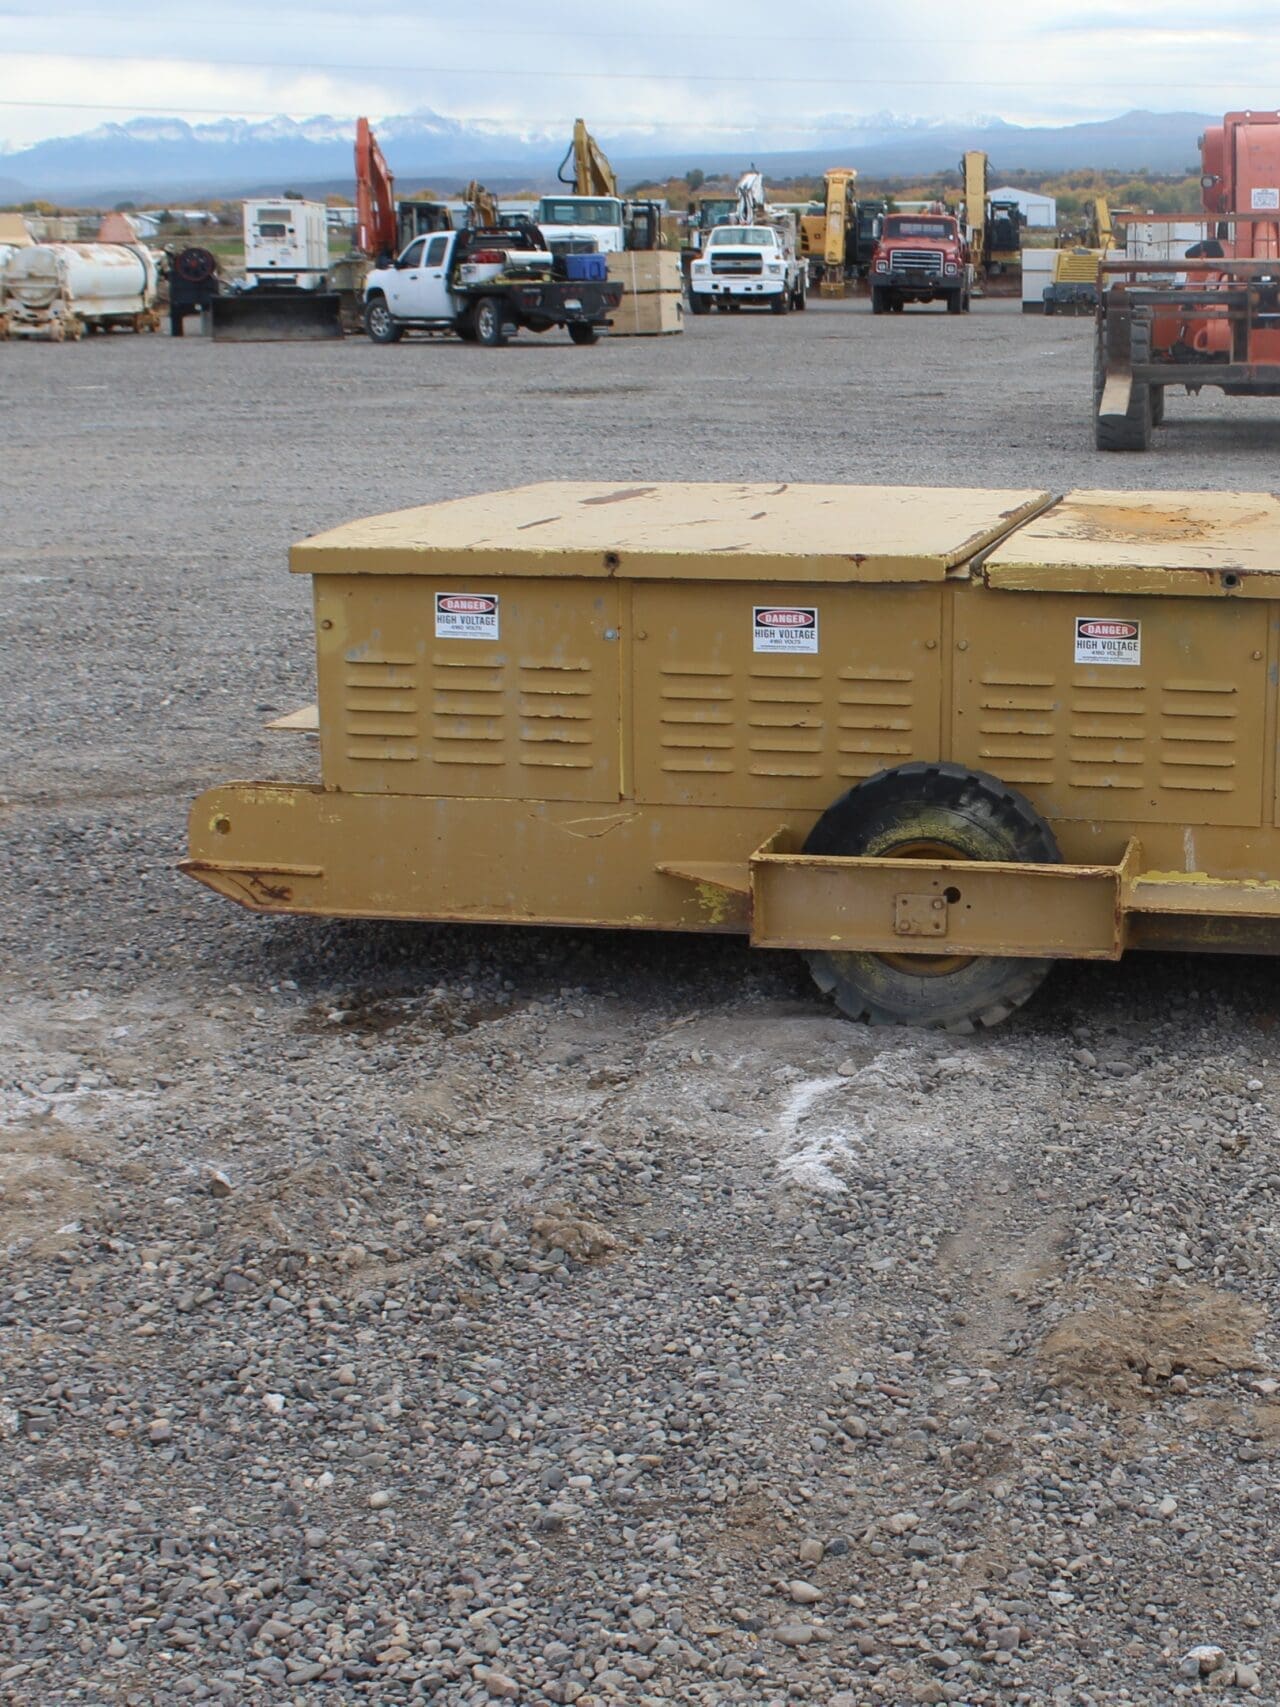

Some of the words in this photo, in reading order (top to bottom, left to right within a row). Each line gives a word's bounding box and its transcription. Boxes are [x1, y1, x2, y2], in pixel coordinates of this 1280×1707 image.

[447, 600, 486, 610] DANGER
[437, 614, 457, 624] HIGH
[460, 615, 496, 626] VOLTAGE
[765, 614, 805, 624] DANGER
[755, 629, 776, 638] HIGH
[779, 630, 816, 640] VOLTAGE
[1088, 625, 1129, 635] DANGER
[1077, 640, 1098, 650] HIGH
[1101, 640, 1139, 651] VOLTAGE
